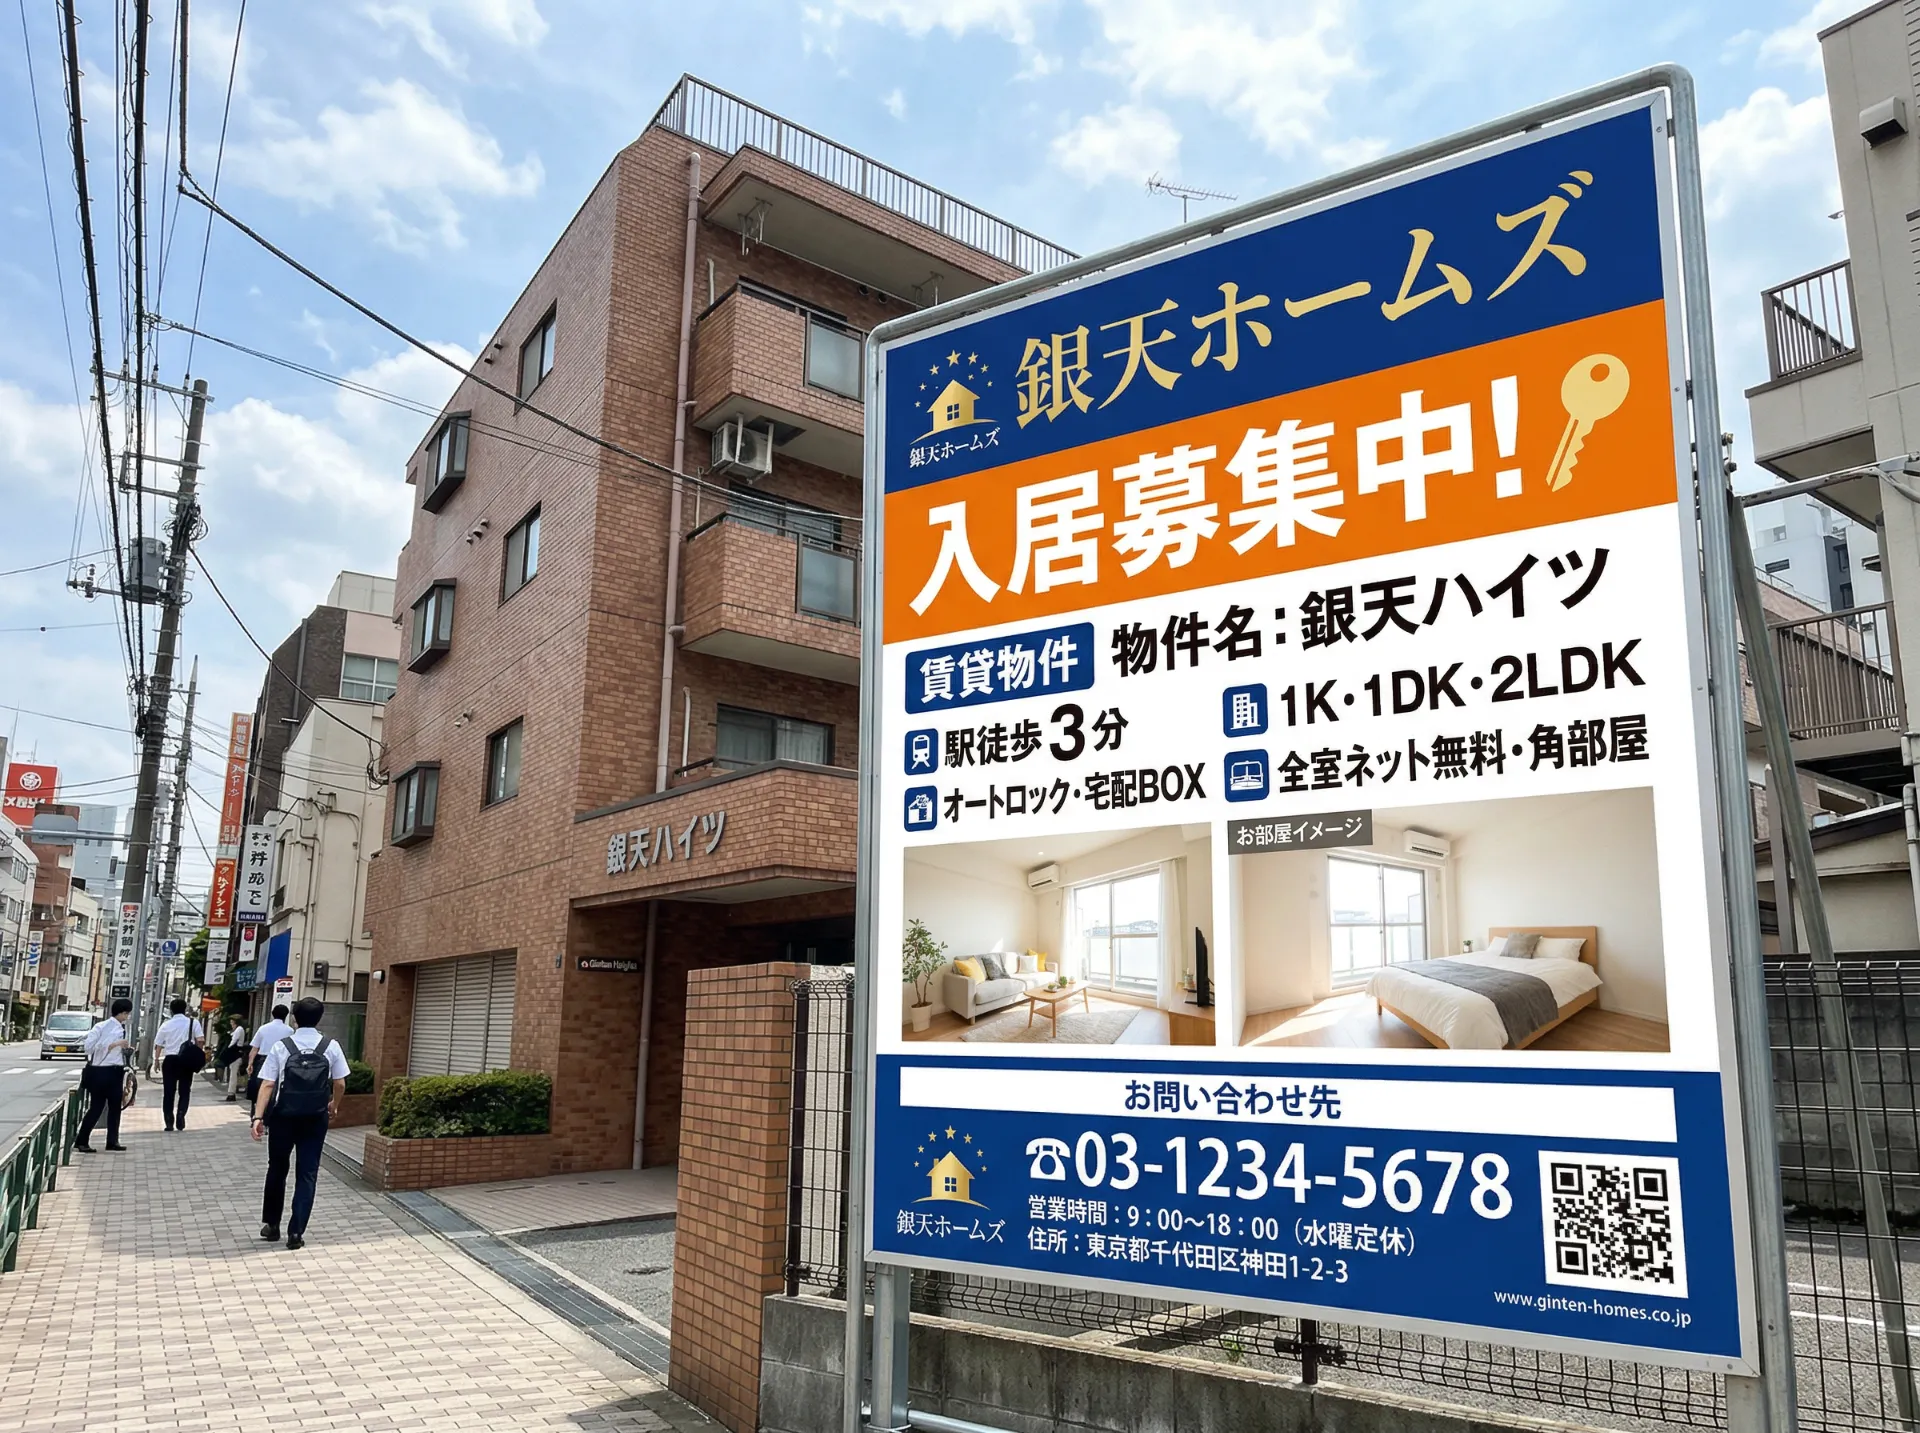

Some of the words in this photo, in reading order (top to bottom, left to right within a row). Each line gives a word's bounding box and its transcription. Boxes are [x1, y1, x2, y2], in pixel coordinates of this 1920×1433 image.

[1015, 171, 1593, 429] 銀天ホームズ
[909, 427, 1001, 468] 銀天ホームズ
[910, 375, 1522, 615] 入居募集中!
[919, 635, 1078, 704] 賃貸物件
[944, 703, 1129, 769] 駅徒歩3分
[607, 810, 725, 875] 銀天ハイツ
[1236, 816, 1363, 846] お部屋イメージ
[1124, 1079, 1342, 1120] お問い合わせ先
[1075, 1130, 1513, 1220] 03-1234-5678
[896, 1209, 1006, 1245] 銀天ホームズ
[1493, 1289, 1692, 1329] www.ginten-homes.co.jp
